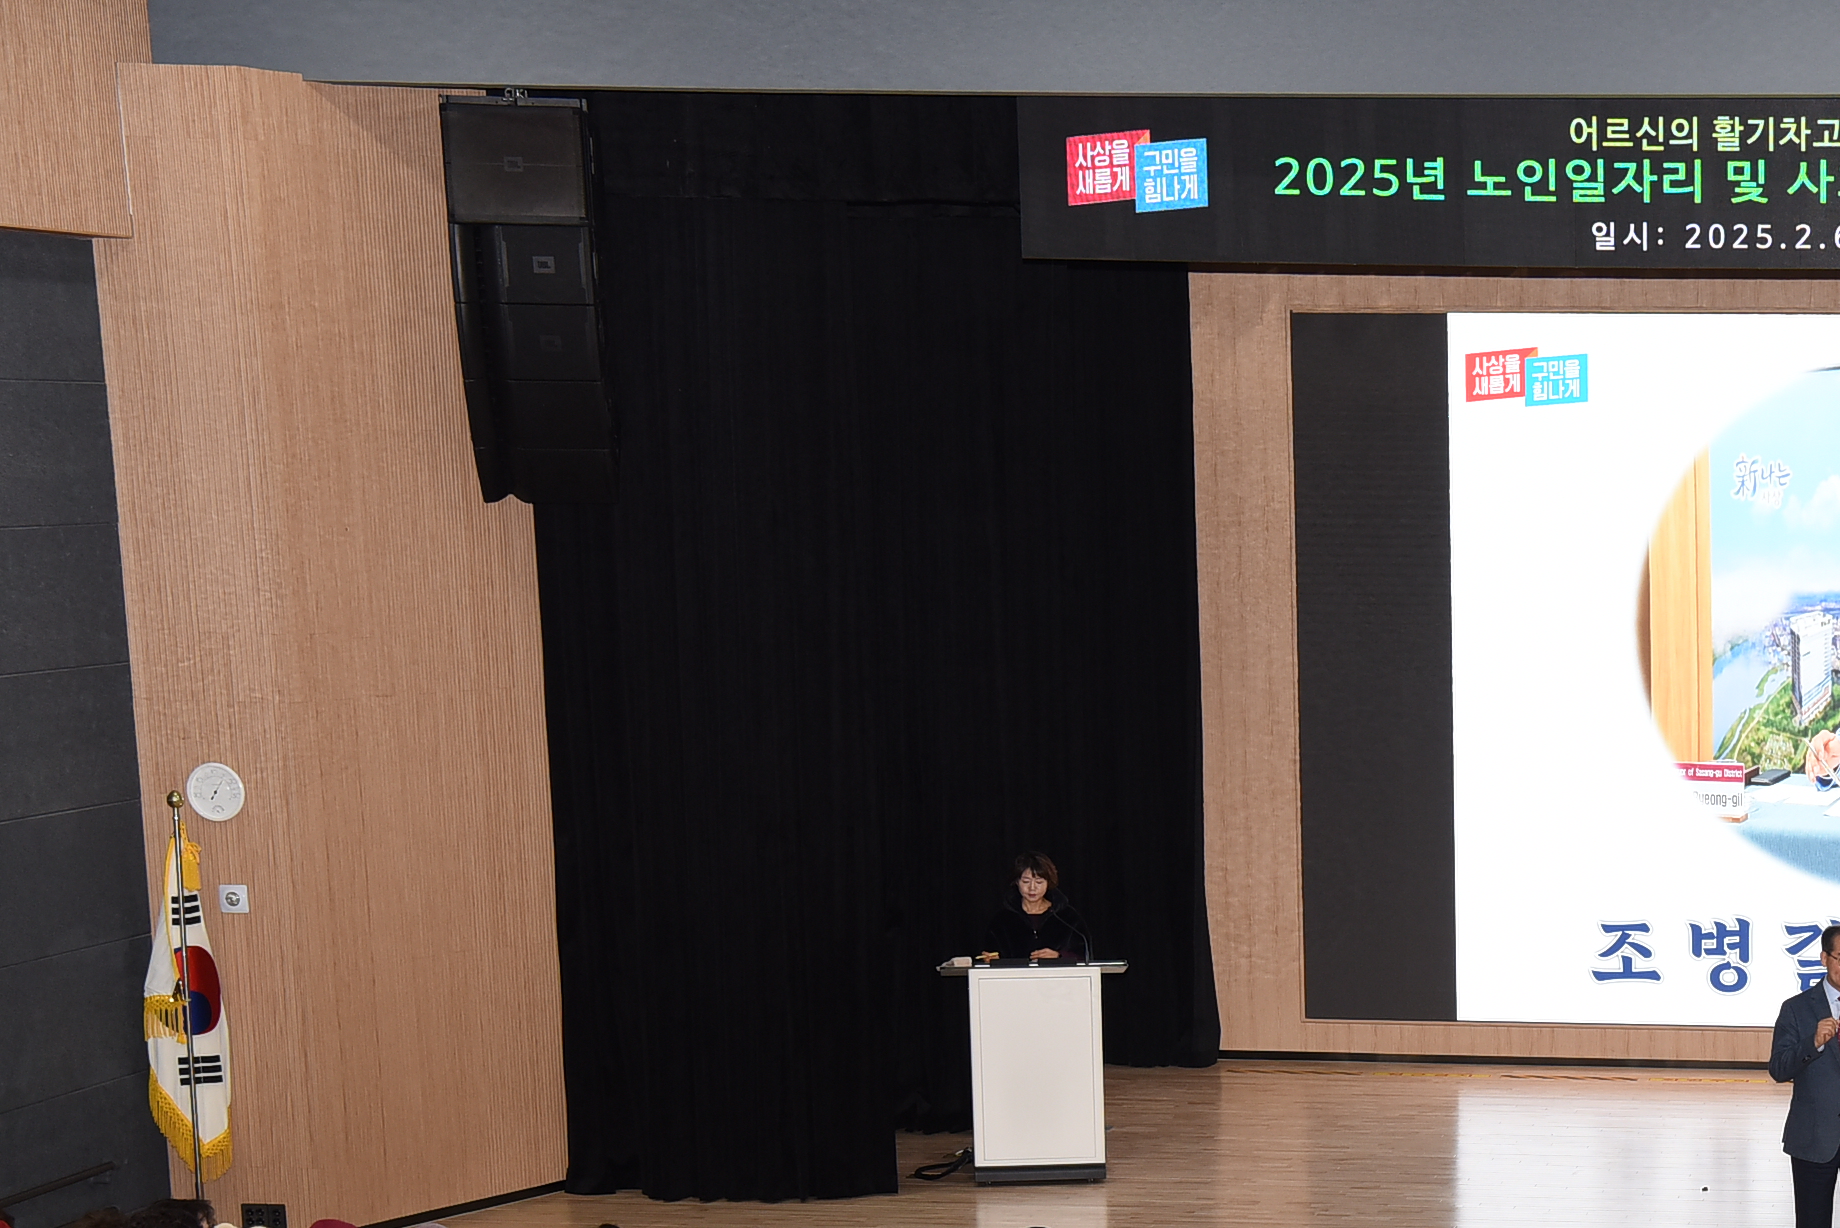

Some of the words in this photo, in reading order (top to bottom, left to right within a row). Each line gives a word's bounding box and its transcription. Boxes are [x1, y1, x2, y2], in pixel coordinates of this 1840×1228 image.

[1570, 116, 1697, 151] 어르신의
[1074, 139, 1130, 168] 사상을
[1143, 147, 1198, 176] 구민을
[1075, 166, 1130, 195] 새롭게
[1143, 174, 1198, 204] 힘나게
[1275, 157, 1444, 201] 2025년
[1467, 159, 1701, 203] 노인일자리
[1728, 160, 1768, 203] 및
[1591, 222, 1664, 251] 일시:
[1471, 354, 1521, 375] 사상을
[1531, 359, 1581, 381] 구민을
[1472, 373, 1521, 396] 새롭게
[1531, 379, 1581, 402] 힘나게
[1693, 790, 1743, 807] yeong-gil
